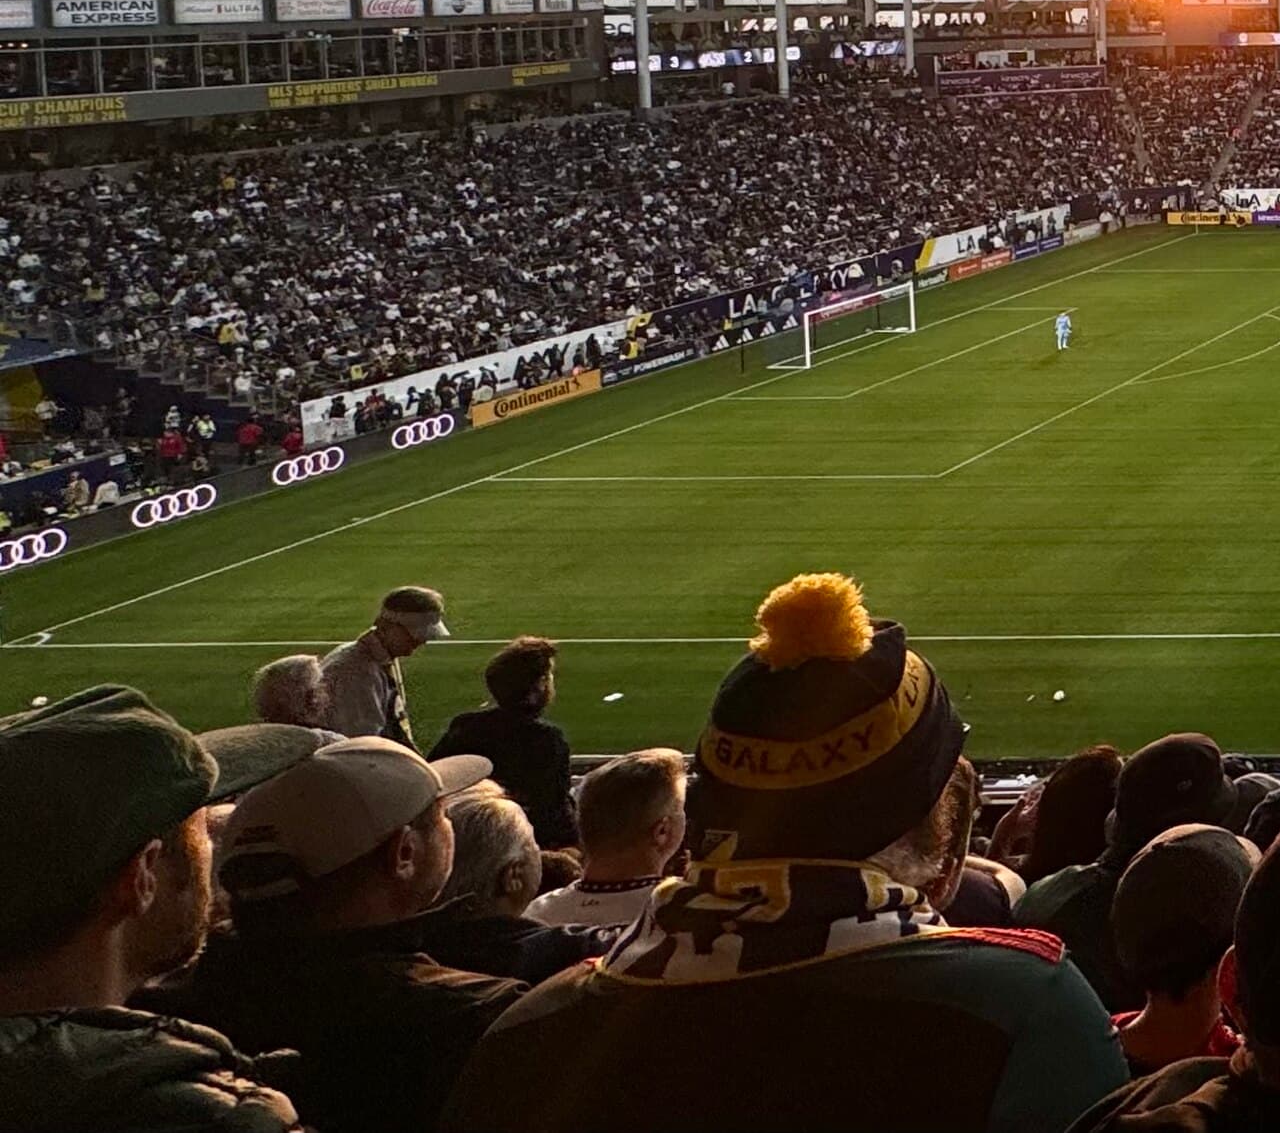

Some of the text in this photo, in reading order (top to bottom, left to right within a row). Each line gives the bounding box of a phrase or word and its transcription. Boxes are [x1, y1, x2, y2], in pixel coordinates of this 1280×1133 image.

[56, 0, 154, 12] AMERICAN
[224, 4, 260, 13] ULTRA
[71, 12, 157, 24] EXPRESS
[0, 97, 125, 116] CUP CHAMPIONS
[956, 234, 976, 254] LA
[728, 294, 758, 318] LA
[493, 383, 571, 417] Continental
[714, 722, 874, 775] GALAXY
